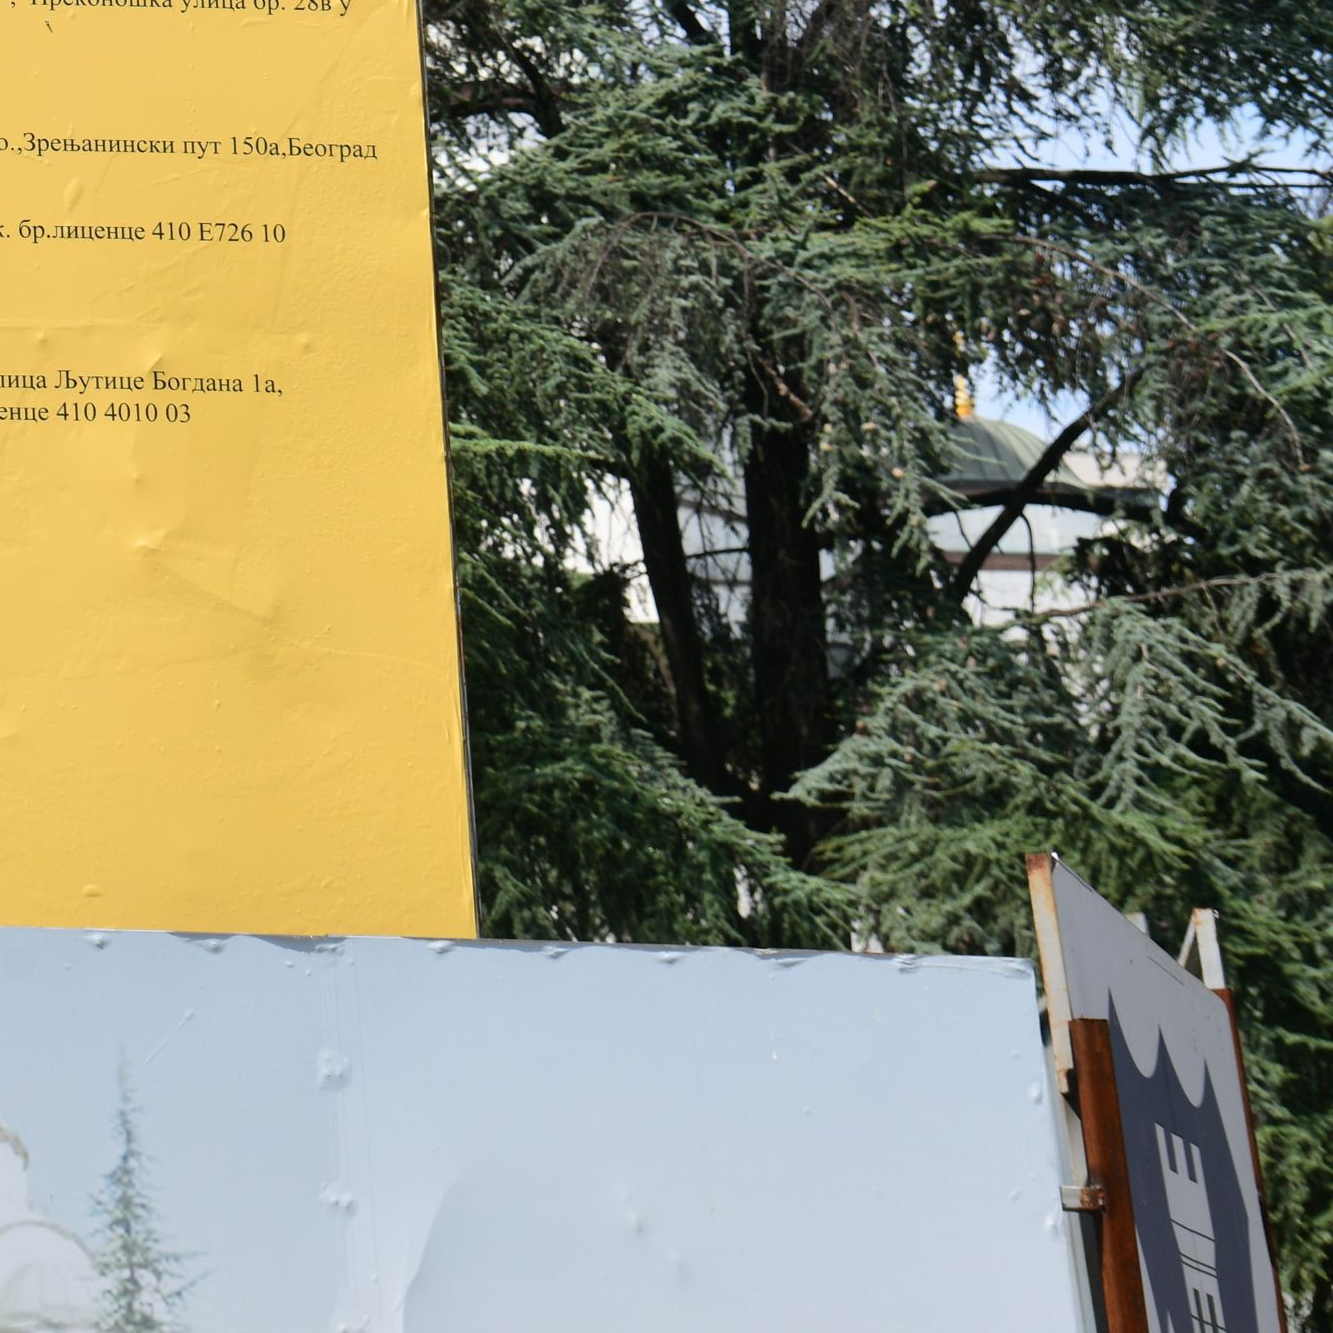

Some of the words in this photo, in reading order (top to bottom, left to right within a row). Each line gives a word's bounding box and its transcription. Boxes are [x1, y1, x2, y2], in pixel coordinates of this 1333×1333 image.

[338, 0, 352, 18] у
[182, 141, 222, 160] пут
[18, 219, 146, 245] бр.лиценце
[151, 222, 192, 242] 410
[261, 224, 286, 244] 10
[53, 370, 145, 395] Љутице
[149, 369, 244, 395] Богдана
[55, 402, 97, 422] 410
[103, 403, 159, 423] 4010
[165, 403, 191, 424] 03
